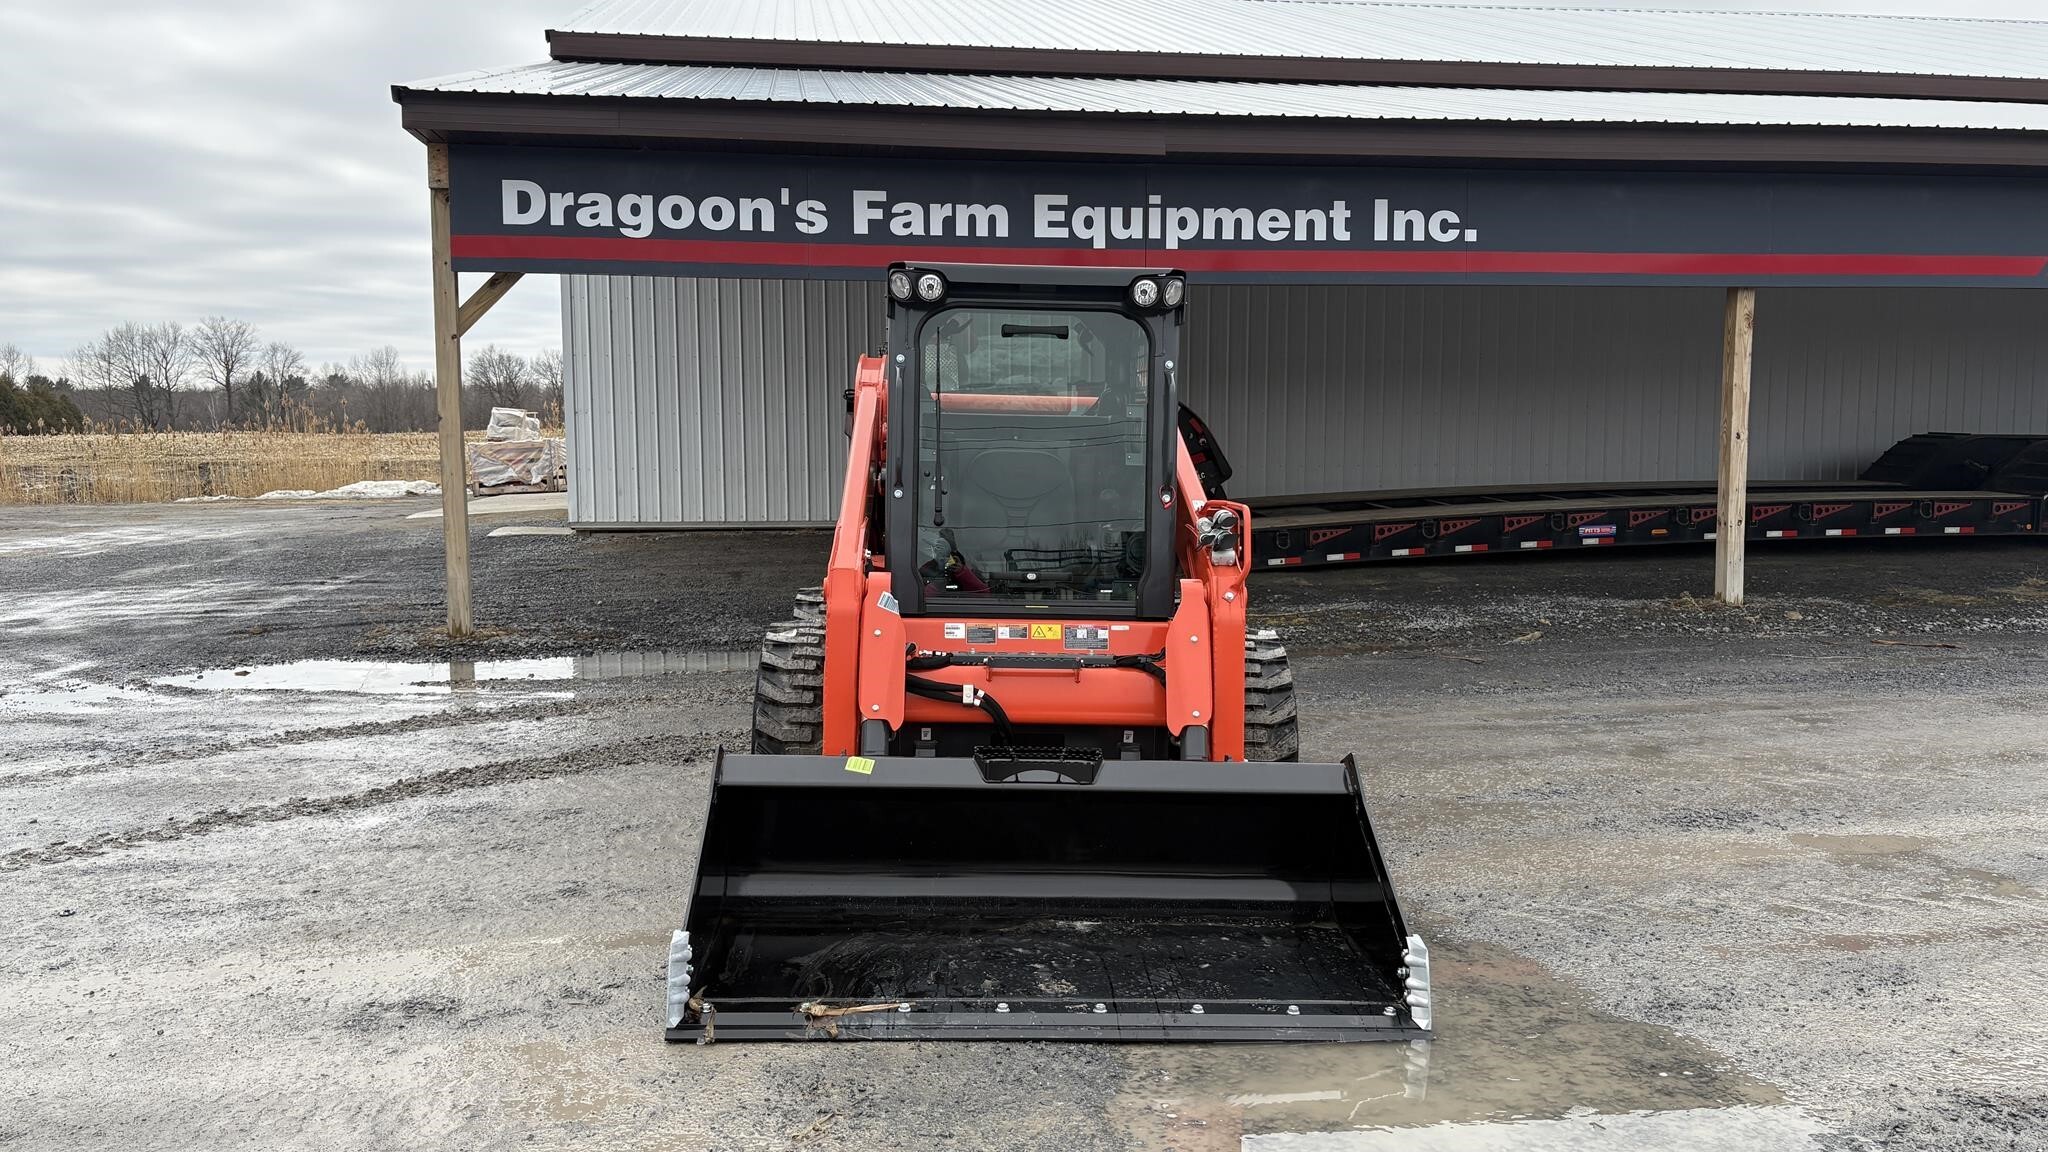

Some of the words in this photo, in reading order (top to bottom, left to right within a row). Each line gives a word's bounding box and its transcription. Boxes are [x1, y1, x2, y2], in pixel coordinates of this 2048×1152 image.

[501, 179, 829, 239] Dragoon's
[853, 190, 1009, 238] Farm
[1034, 194, 1351, 250] Equipment
[1373, 199, 1478, 243] Inc.
